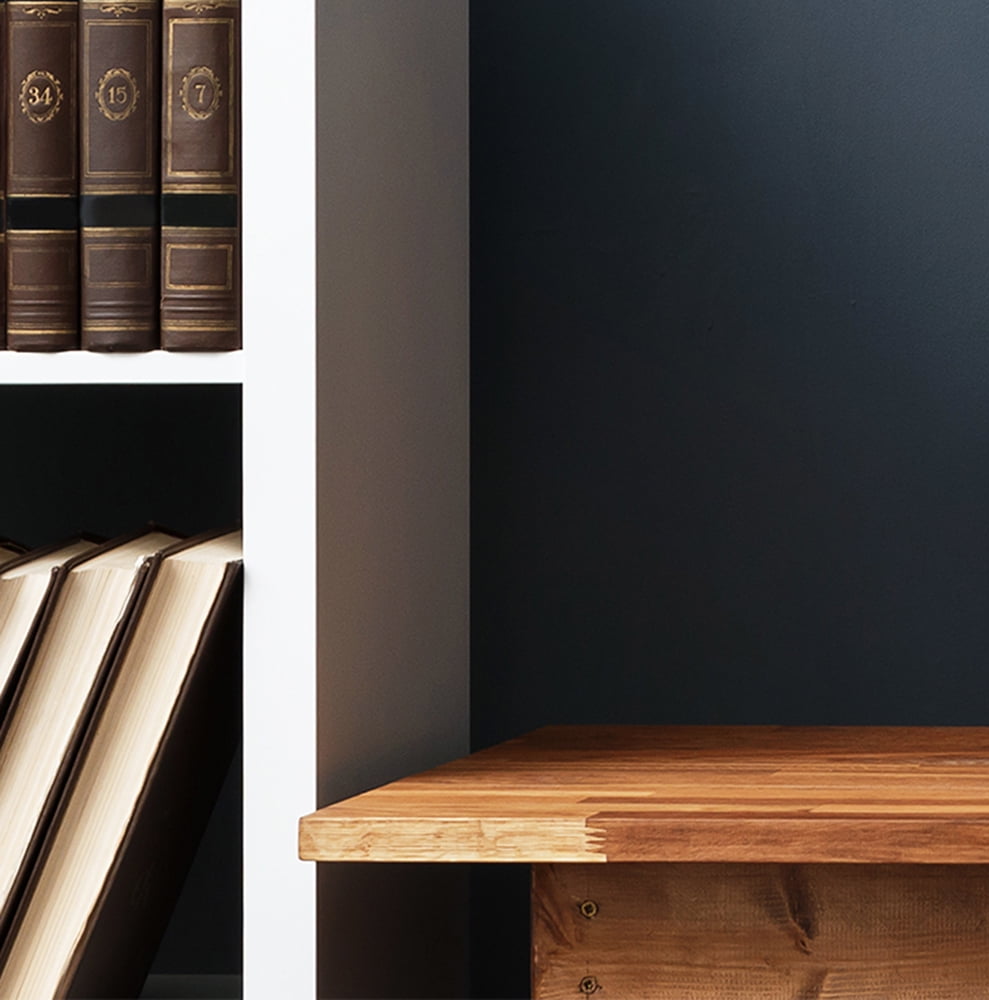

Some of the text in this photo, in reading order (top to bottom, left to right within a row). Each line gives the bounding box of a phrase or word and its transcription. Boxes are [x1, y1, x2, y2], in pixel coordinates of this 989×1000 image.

[28, 86, 53, 105] 34
[107, 86, 128, 104] 15
[194, 84, 206, 104] 7
